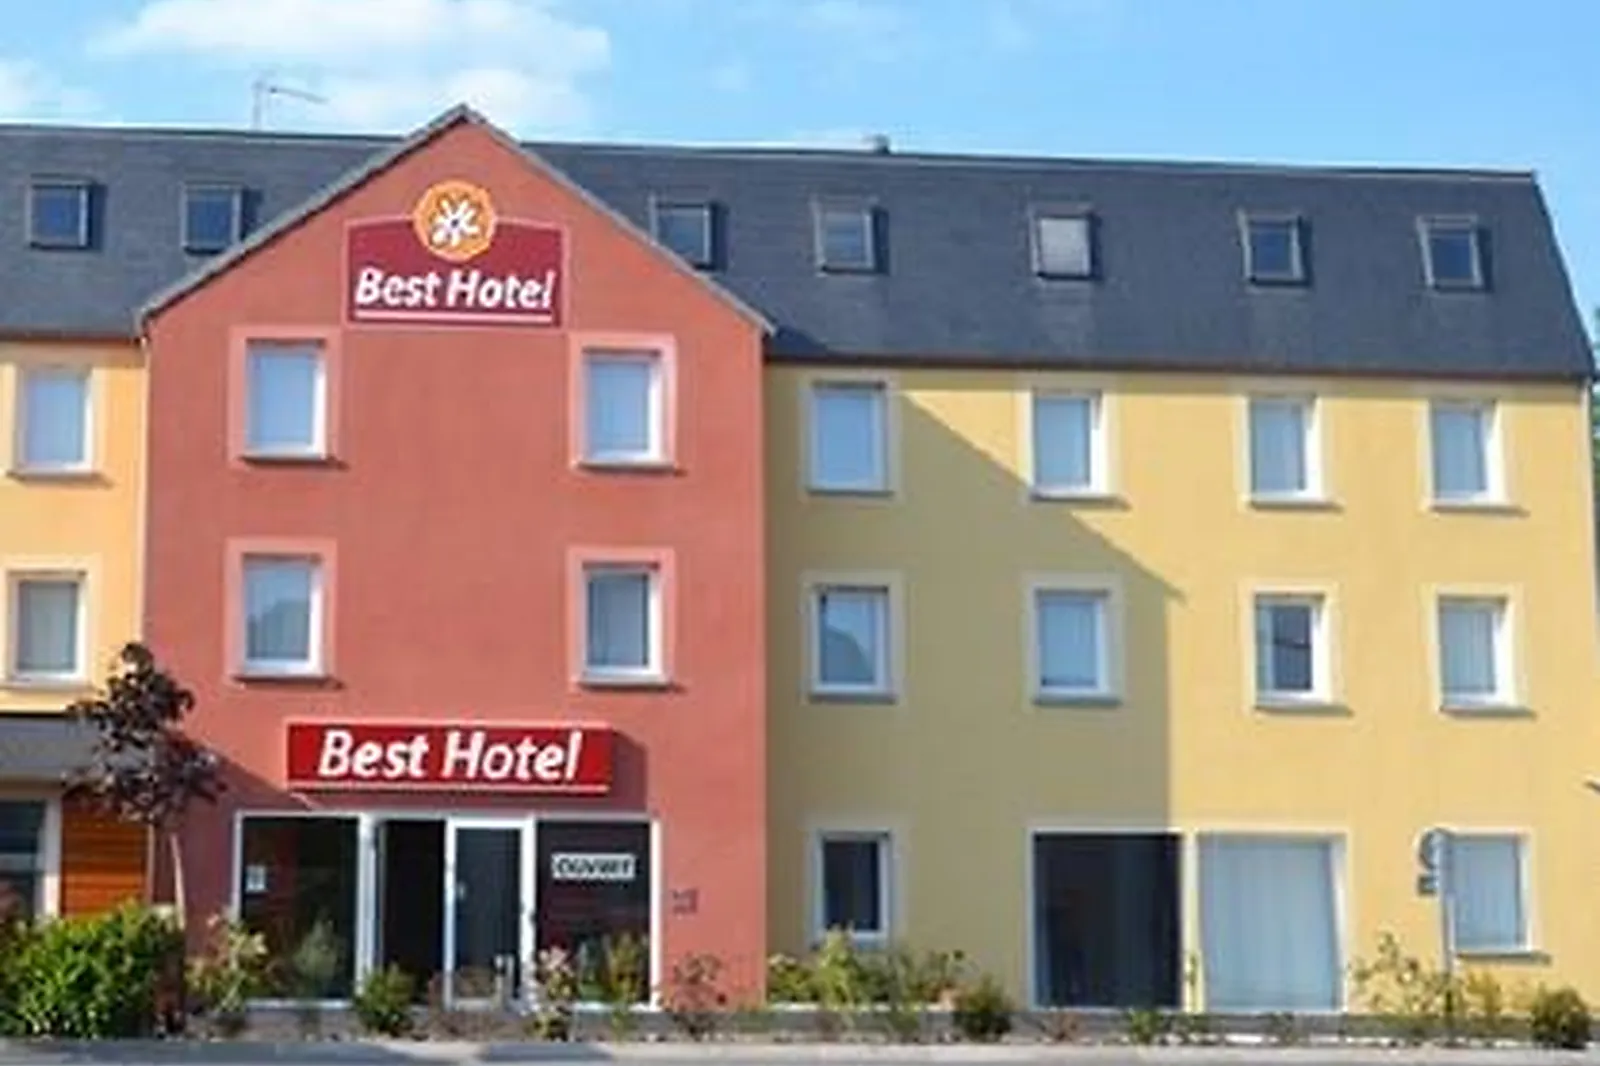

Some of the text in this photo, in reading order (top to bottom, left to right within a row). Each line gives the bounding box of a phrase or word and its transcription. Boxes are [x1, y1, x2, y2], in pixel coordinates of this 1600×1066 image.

[355, 267, 556, 309] Best Hotel
[318, 729, 583, 780] Best Hotel
